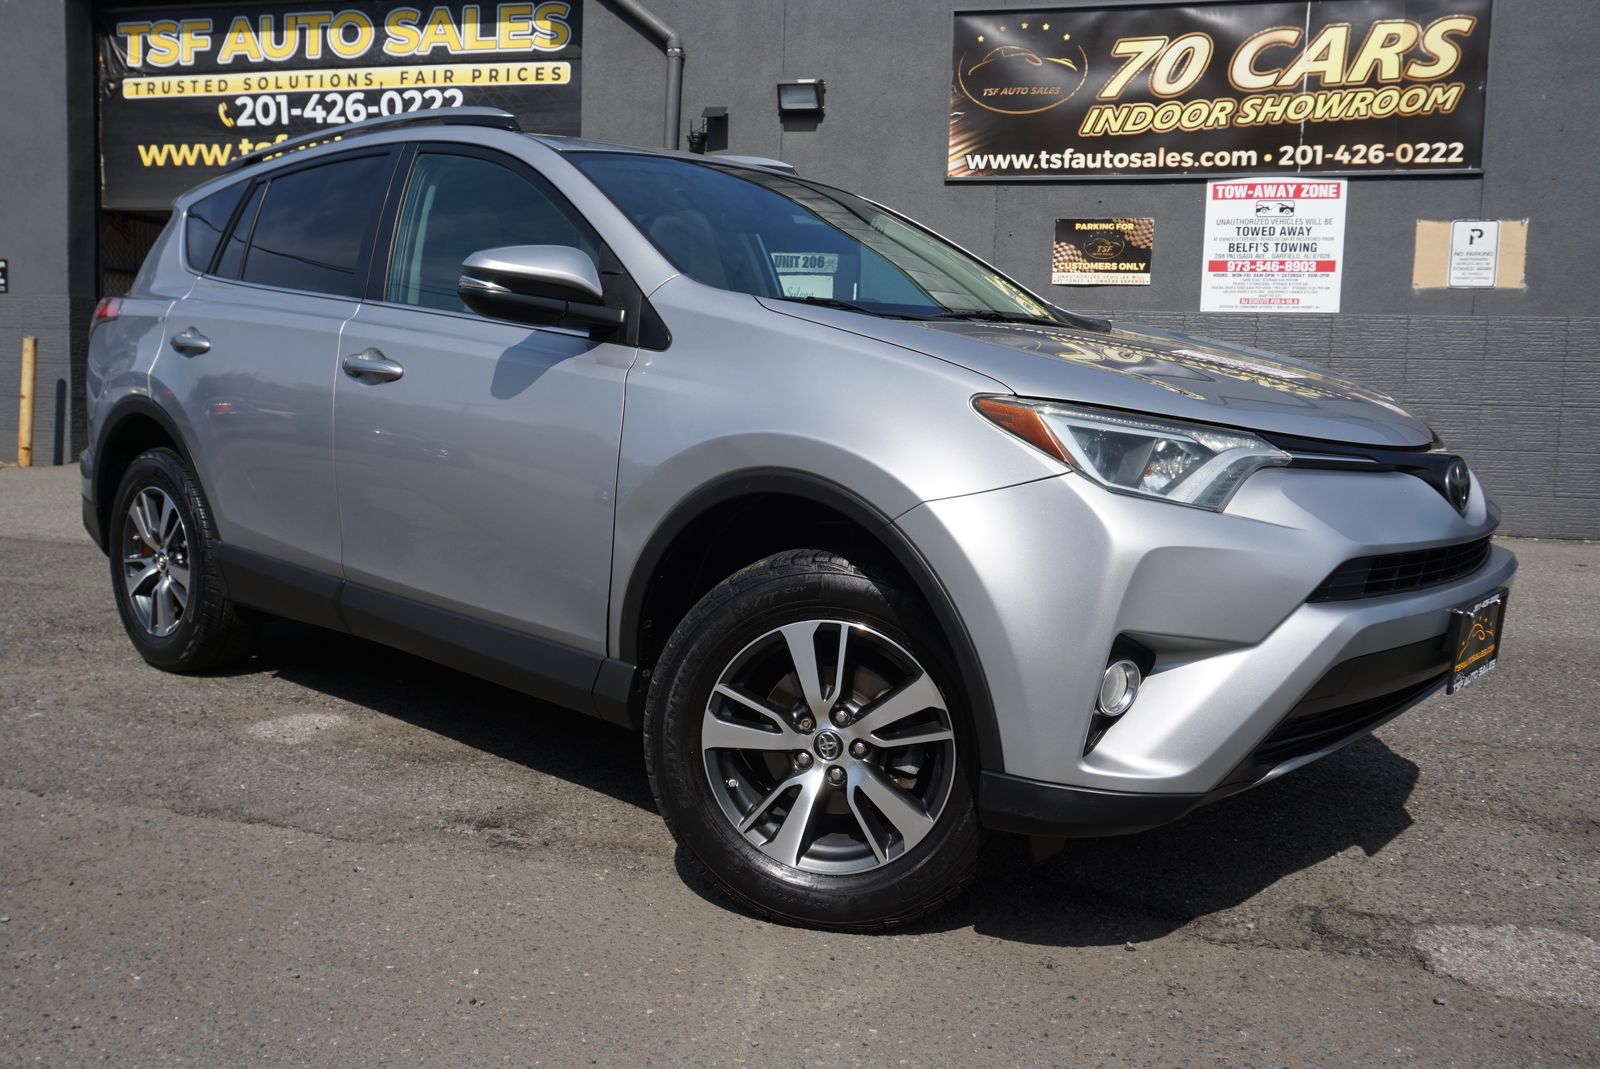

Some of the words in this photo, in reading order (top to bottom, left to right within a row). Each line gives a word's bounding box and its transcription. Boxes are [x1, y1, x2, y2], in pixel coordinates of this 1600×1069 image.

[117, 18, 213, 67] TSF
[217, 9, 375, 64] AUTO
[383, 1, 571, 56] SALES
[1097, 31, 1215, 99] 70
[1226, 14, 1478, 93] CARS
[132, 79, 228, 95] TRUSTED
[243, 72, 383, 91] SOLUTIONS,
[400, 69, 454, 84] FAIR
[471, 67, 562, 82] PRICES
[983, 88, 999, 96] TSF
[1000, 87, 1029, 95] AUTO
[1030, 86, 1061, 95] SALES
[1078, 100, 1234, 136] INDOOR
[1235, 83, 1466, 127] SHOWROOM
[966, 146, 1258, 171] www.tsfautosales.com
[1278, 141, 1465, 167] 201-426-0222
[1216, 184, 1296, 198] TOW-AWAY
[1301, 183, 1337, 197] ZONE
[1216, 218, 1269, 226] UNAUTHORIZED
[1235, 226, 1275, 236] TOWED
[1279, 226, 1312, 236] AWAY
[1228, 242, 1269, 252] BELFI'S
[1274, 242, 1318, 252] TOWING
[774, 255, 800, 268] UNIT
[802, 256, 825, 268] 206
[1059, 262, 1117, 270] CUSTOMERS
[1119, 262, 1146, 270] ONLY
[1227, 261, 1316, 271] 973-546-8903
